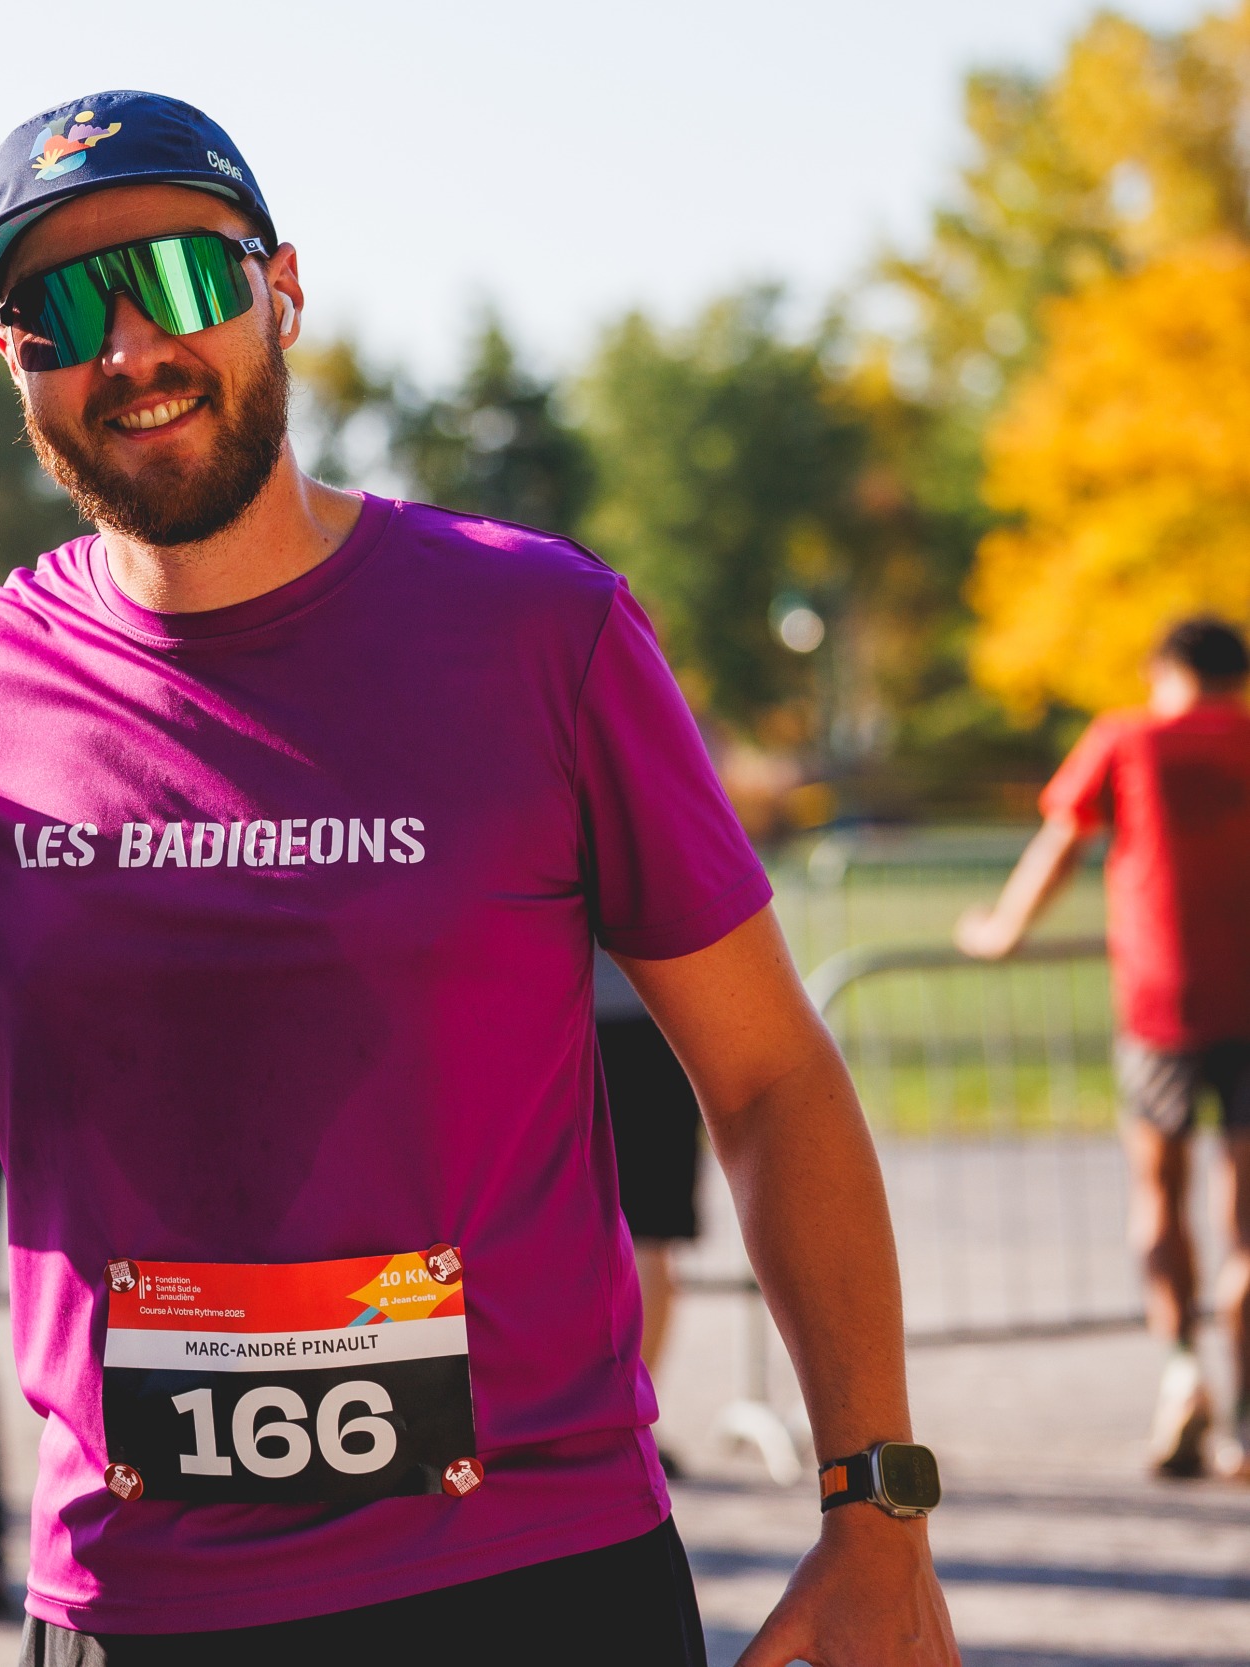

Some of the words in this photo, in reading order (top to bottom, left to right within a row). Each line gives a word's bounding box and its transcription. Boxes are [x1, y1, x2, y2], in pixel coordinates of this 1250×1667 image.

[15, 823, 98, 868] LES
[118, 818, 426, 868] BADIGEONS
[155, 1276, 190, 1284] Fondation
[380, 1271, 401, 1287] 10
[405, 1268, 432, 1284] KM
[156, 1285, 176, 1293] Santé
[177, 1285, 191, 1293] Sud
[192, 1285, 201, 1293] de
[156, 1293, 195, 1301] Lanaudière
[391, 1296, 411, 1305] Jean
[412, 1294, 436, 1303] Coutu
[139, 1306, 166, 1315] Course
[166, 1305, 173, 1315] À
[173, 1307, 194, 1316] Votre
[194, 1308, 224, 1318] Rythme
[224, 1309, 245, 1318] 2025
[185, 1338, 297, 1358] MARC-ANDRÉ
[302, 1334, 379, 1354] PINAULT
[171, 1380, 397, 1478] 166
